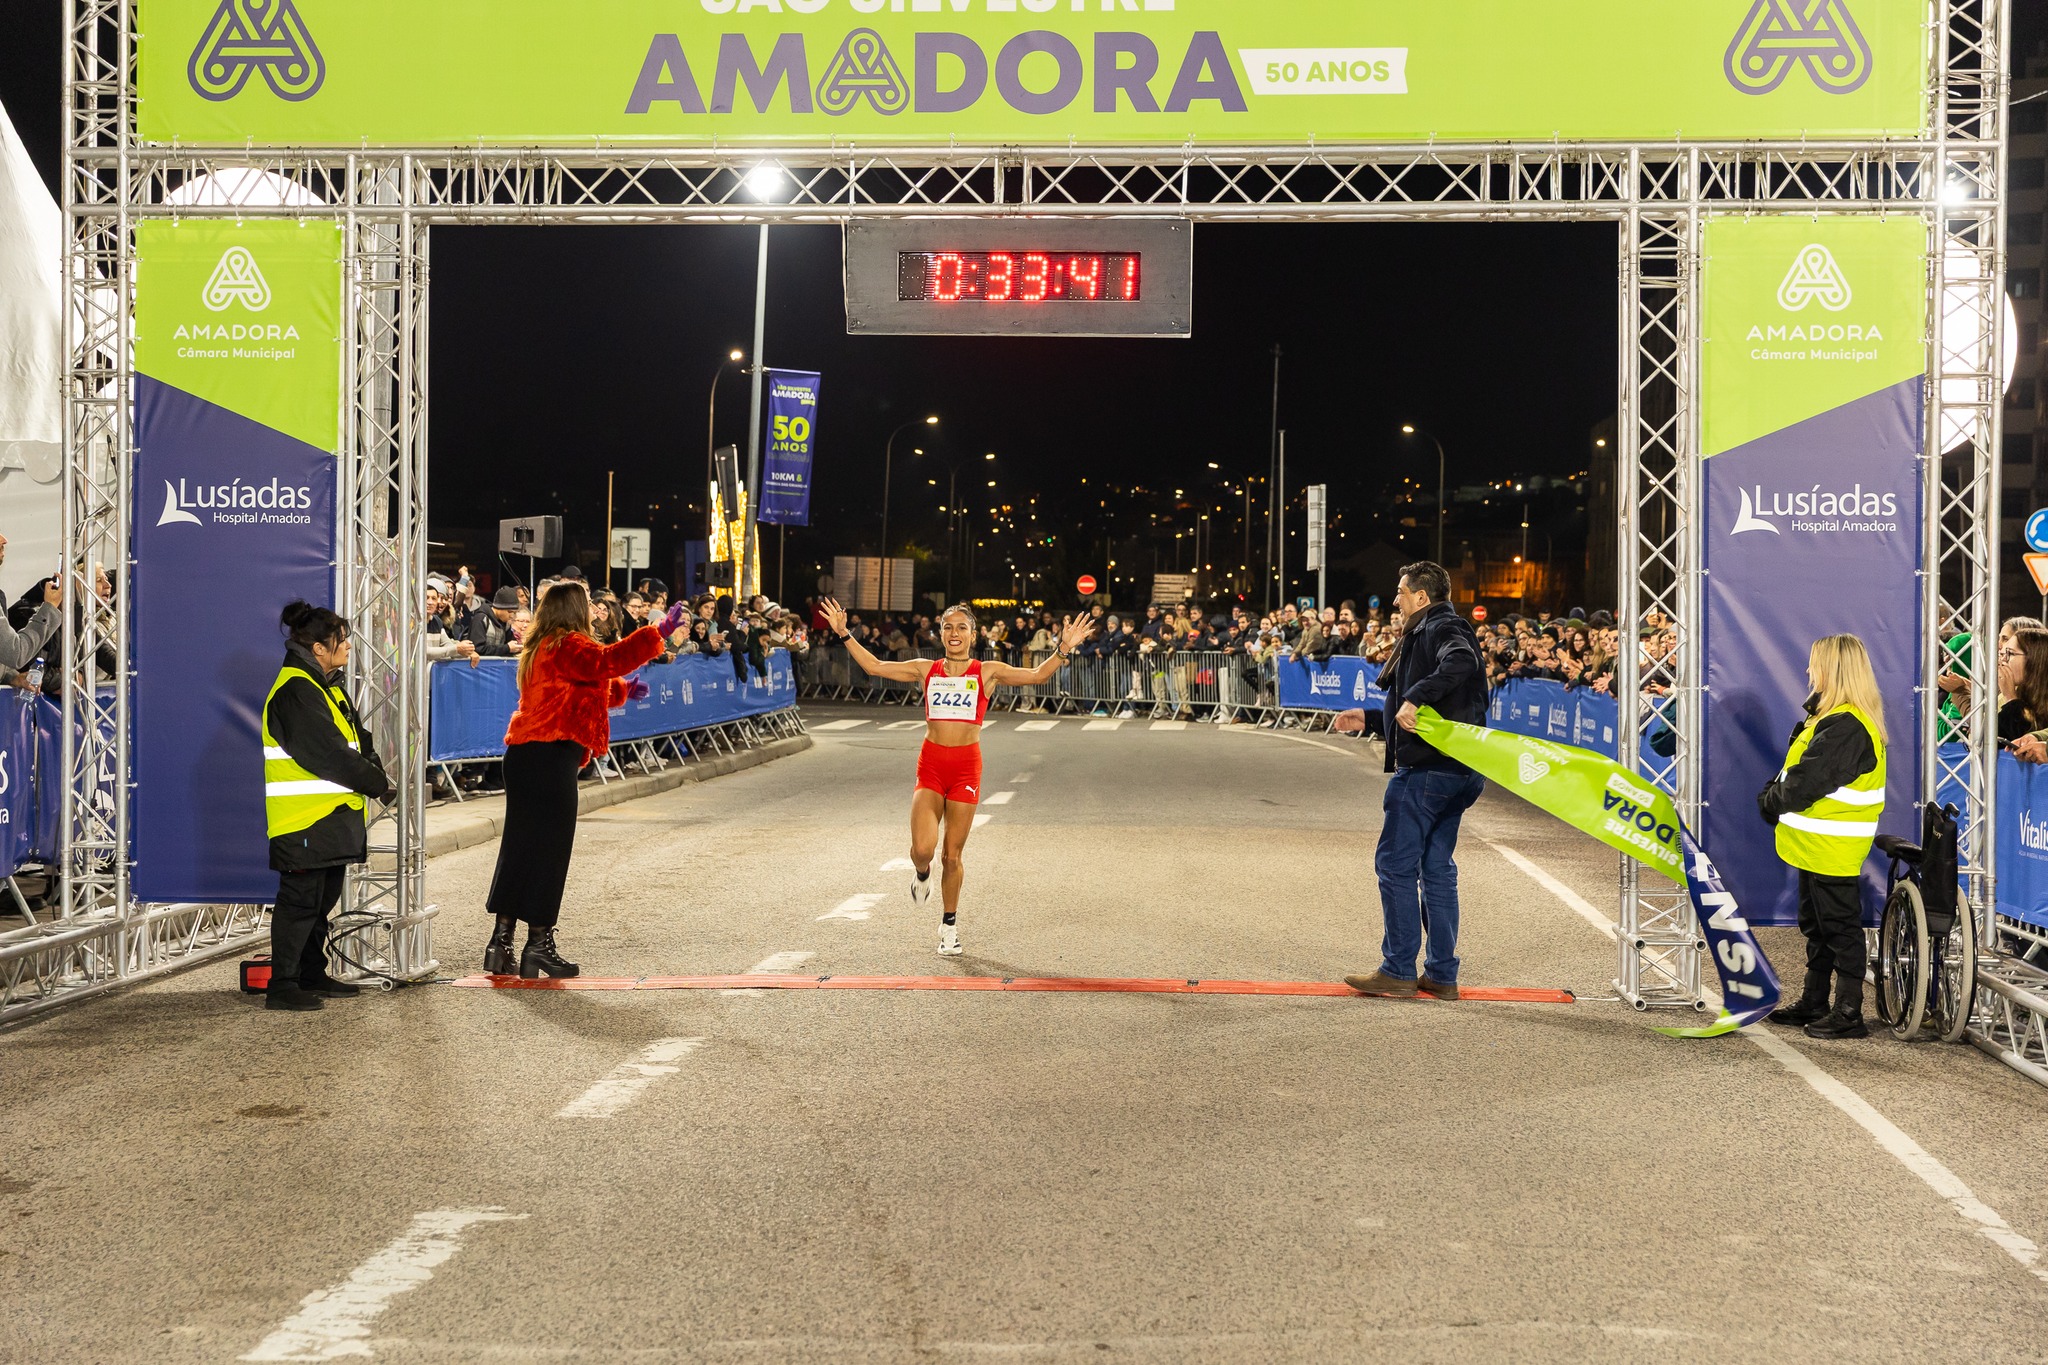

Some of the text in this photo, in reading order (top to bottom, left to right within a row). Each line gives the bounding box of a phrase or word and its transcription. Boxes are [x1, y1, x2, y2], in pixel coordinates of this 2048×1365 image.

[624, 28, 1248, 115] AMADORA
[1266, 60, 1390, 83] 50 ANOS
[933, 254, 1136, 301] 0:33:41
[172, 324, 300, 341] AMADORA
[1746, 324, 1883, 341] AMADORA
[177, 347, 295, 361] Câmara Municipal
[1750, 349, 1878, 363] Câmara Municipal
[772, 389, 815, 400] AMADORA
[773, 415, 810, 442] 50
[772, 441, 808, 453] ANOS
[771, 472, 795, 482] 10KM
[180, 477, 311, 509] Lusíadas
[1755, 483, 1897, 516] Lusíadas
[213, 511, 311, 525] Hospital Amadora
[1791, 519, 1897, 533] Hospital Amadora
[932, 692, 972, 708] 2424
[1603, 818, 1680, 866] SILVESTRE
